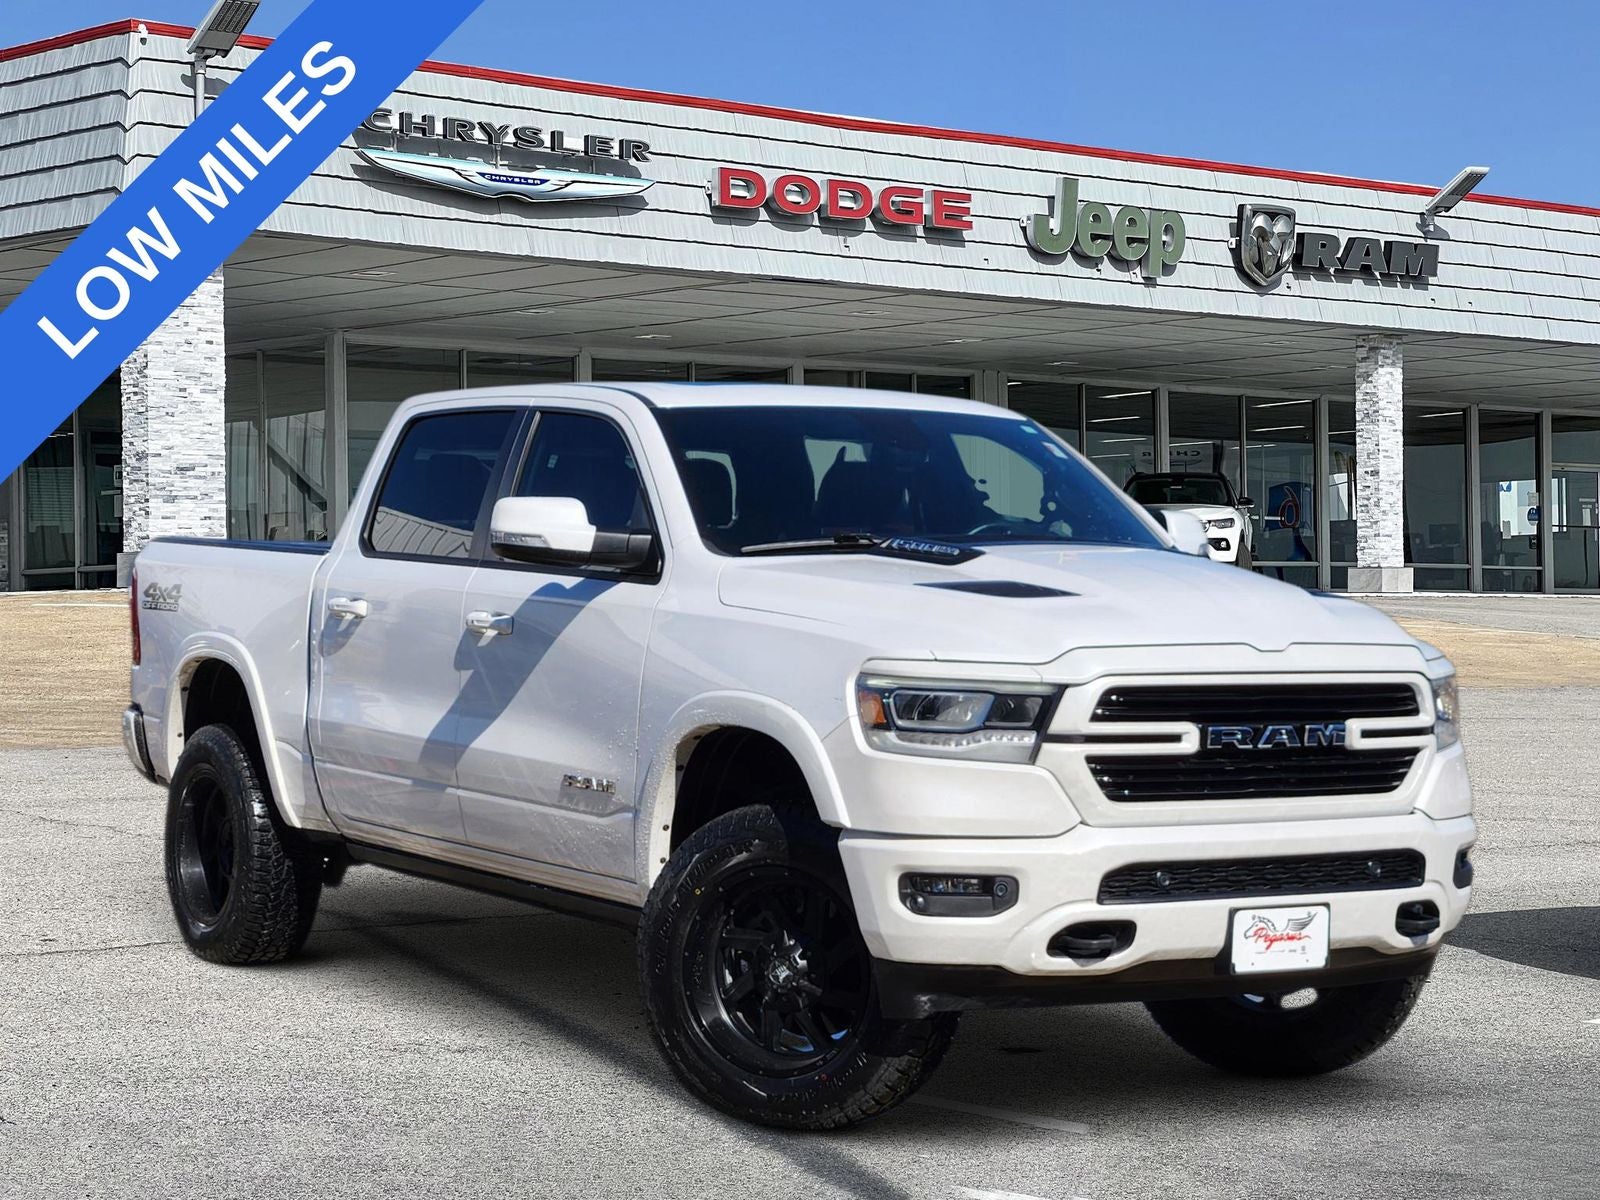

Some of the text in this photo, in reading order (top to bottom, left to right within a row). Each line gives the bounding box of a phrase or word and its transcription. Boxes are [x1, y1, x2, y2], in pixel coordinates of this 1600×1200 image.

[362, 108, 652, 162] CHRYSLER
[484, 173, 541, 185] CHRYSLER
[711, 167, 974, 231] DODGE
[1026, 176, 1186, 278] Jeep
[1296, 232, 1440, 278] RAM
[1207, 724, 1346, 749] RAM
[562, 774, 617, 795] RAM
